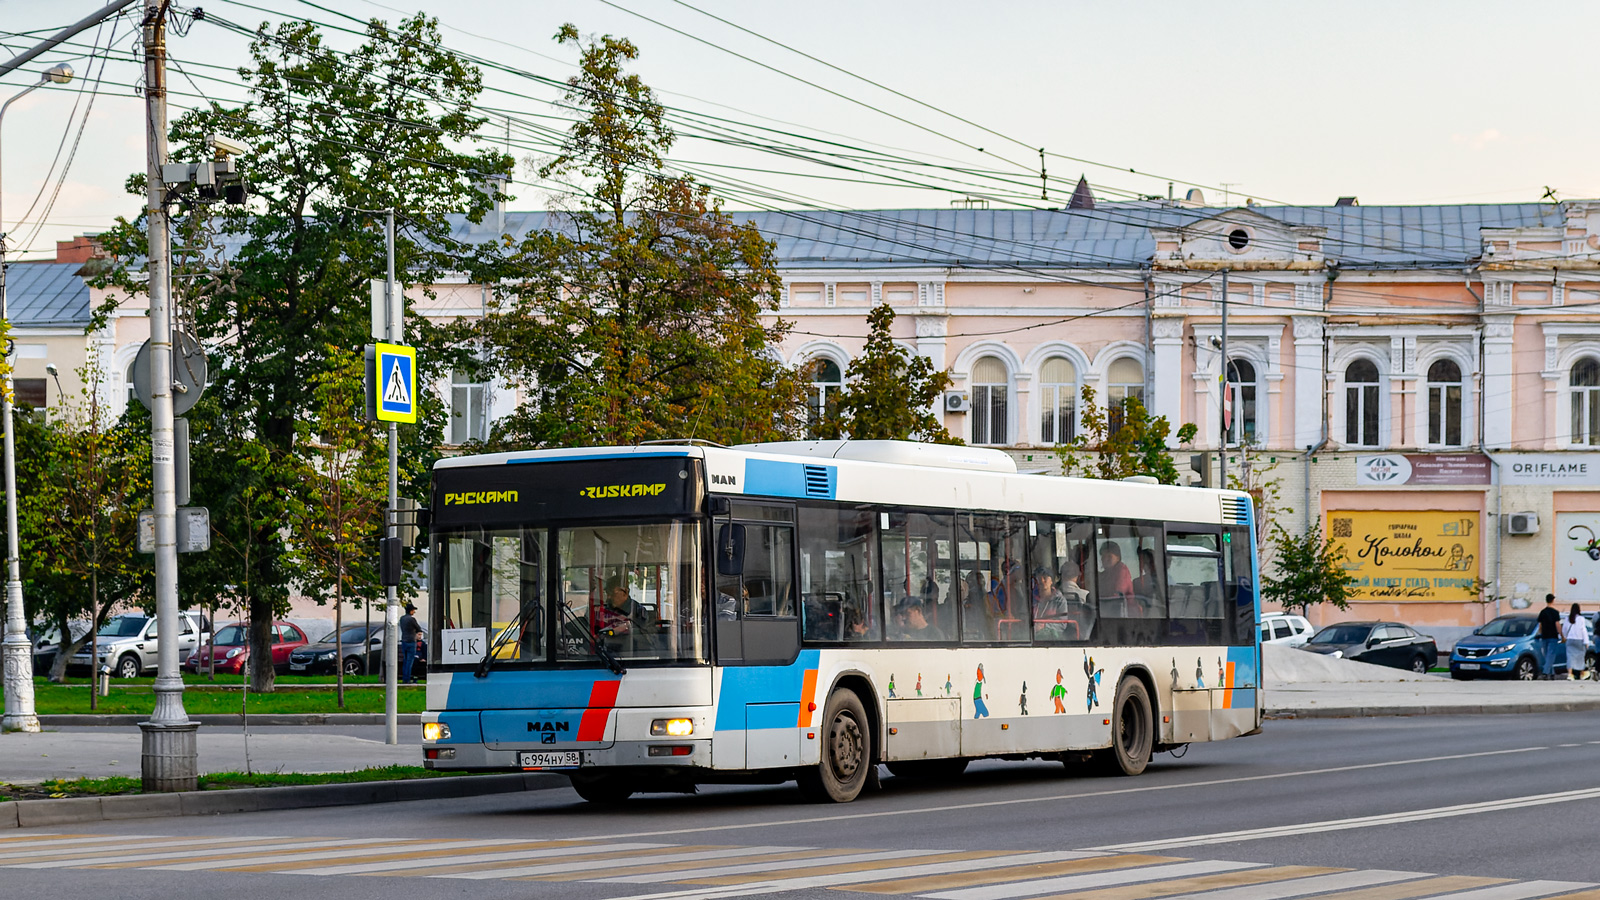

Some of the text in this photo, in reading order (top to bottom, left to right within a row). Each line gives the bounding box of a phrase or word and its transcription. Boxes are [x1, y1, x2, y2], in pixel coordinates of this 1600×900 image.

[1512, 463, 1587, 473] ORIFLAME
[711, 474, 736, 485] MAN
[444, 490, 519, 506] РУСКАМП
[1357, 534, 1447, 566] Колокол
[1372, 577, 1402, 587] МОЖЕТ
[1405, 577, 1430, 588] СТАТЬ
[1433, 577, 1474, 589] ТВОРЦОМ
[527, 721, 569, 732] MAN
